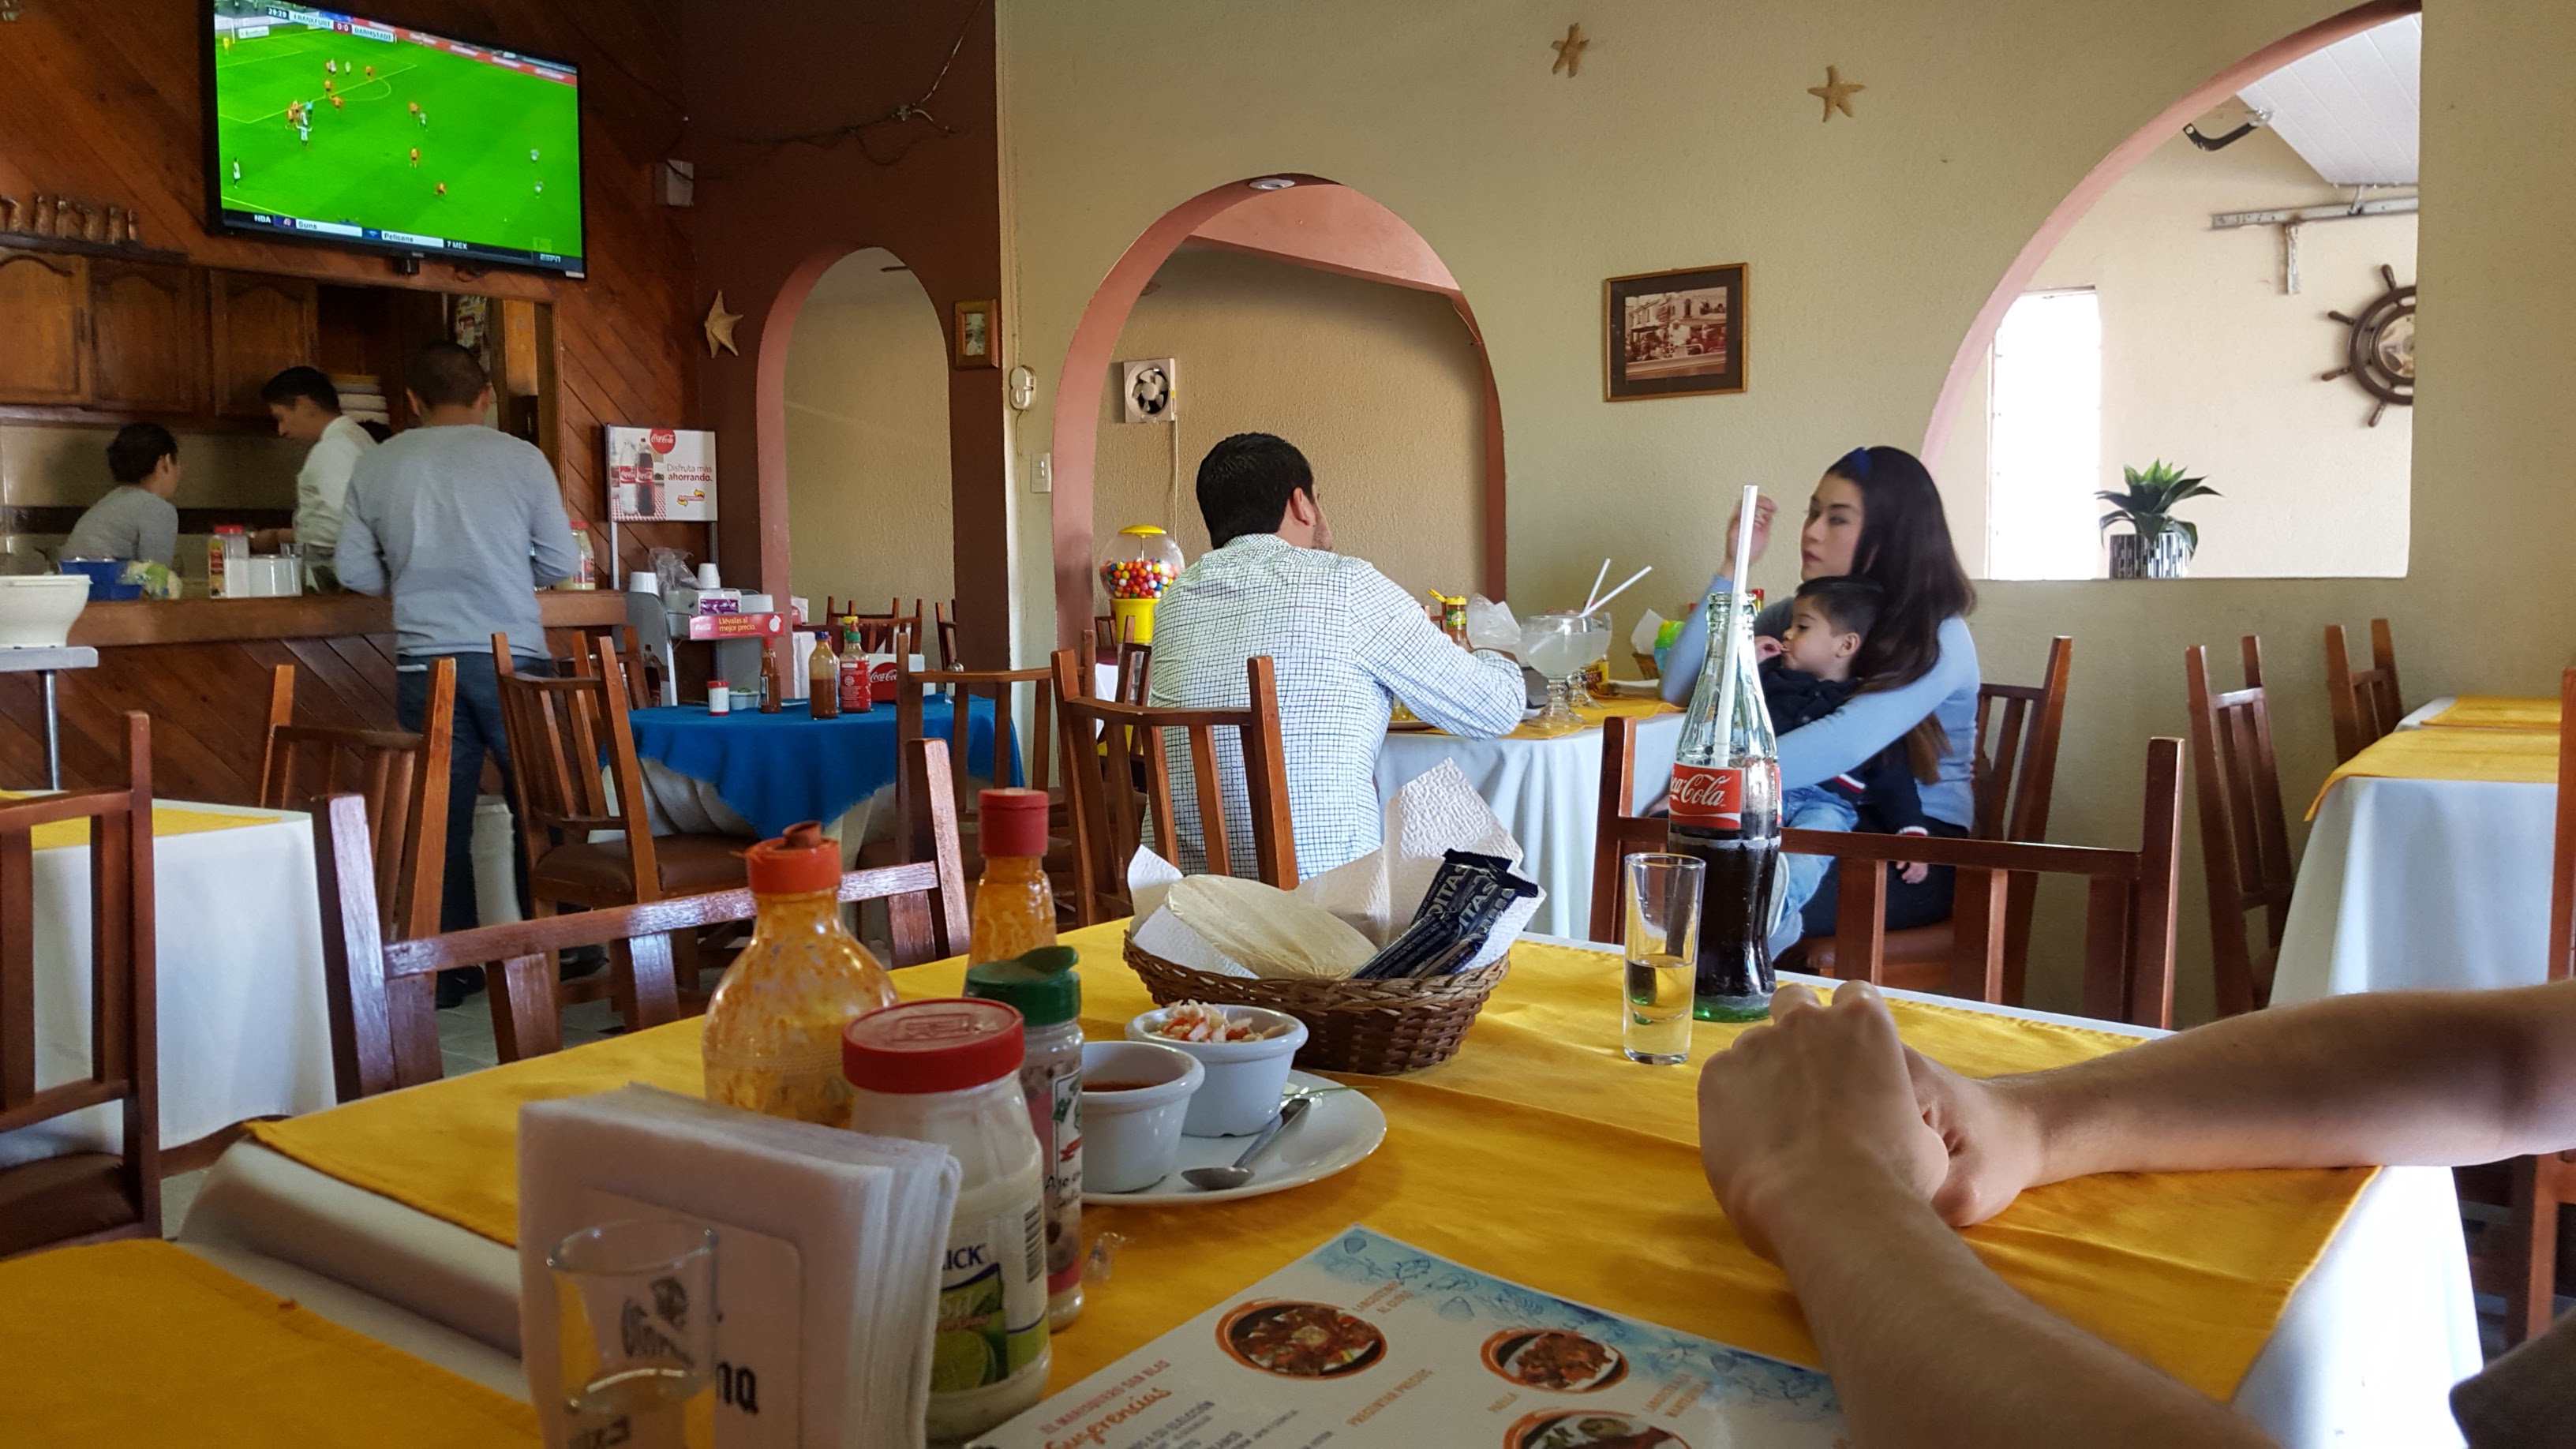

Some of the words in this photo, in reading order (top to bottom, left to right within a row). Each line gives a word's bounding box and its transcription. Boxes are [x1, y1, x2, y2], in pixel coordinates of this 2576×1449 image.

[294, 13, 331, 28] FRANKFURT
[354, 27, 392, 41] DARMSTADT
[254, 214, 271, 224] NBA
[298, 220, 317, 230] Suns
[384, 232, 414, 244] Pelicans
[667, 463, 695, 473] Disfruta
[696, 464, 713, 473] más
[668, 473, 713, 481] ahorrando.
[719, 624, 736, 633] mejor
